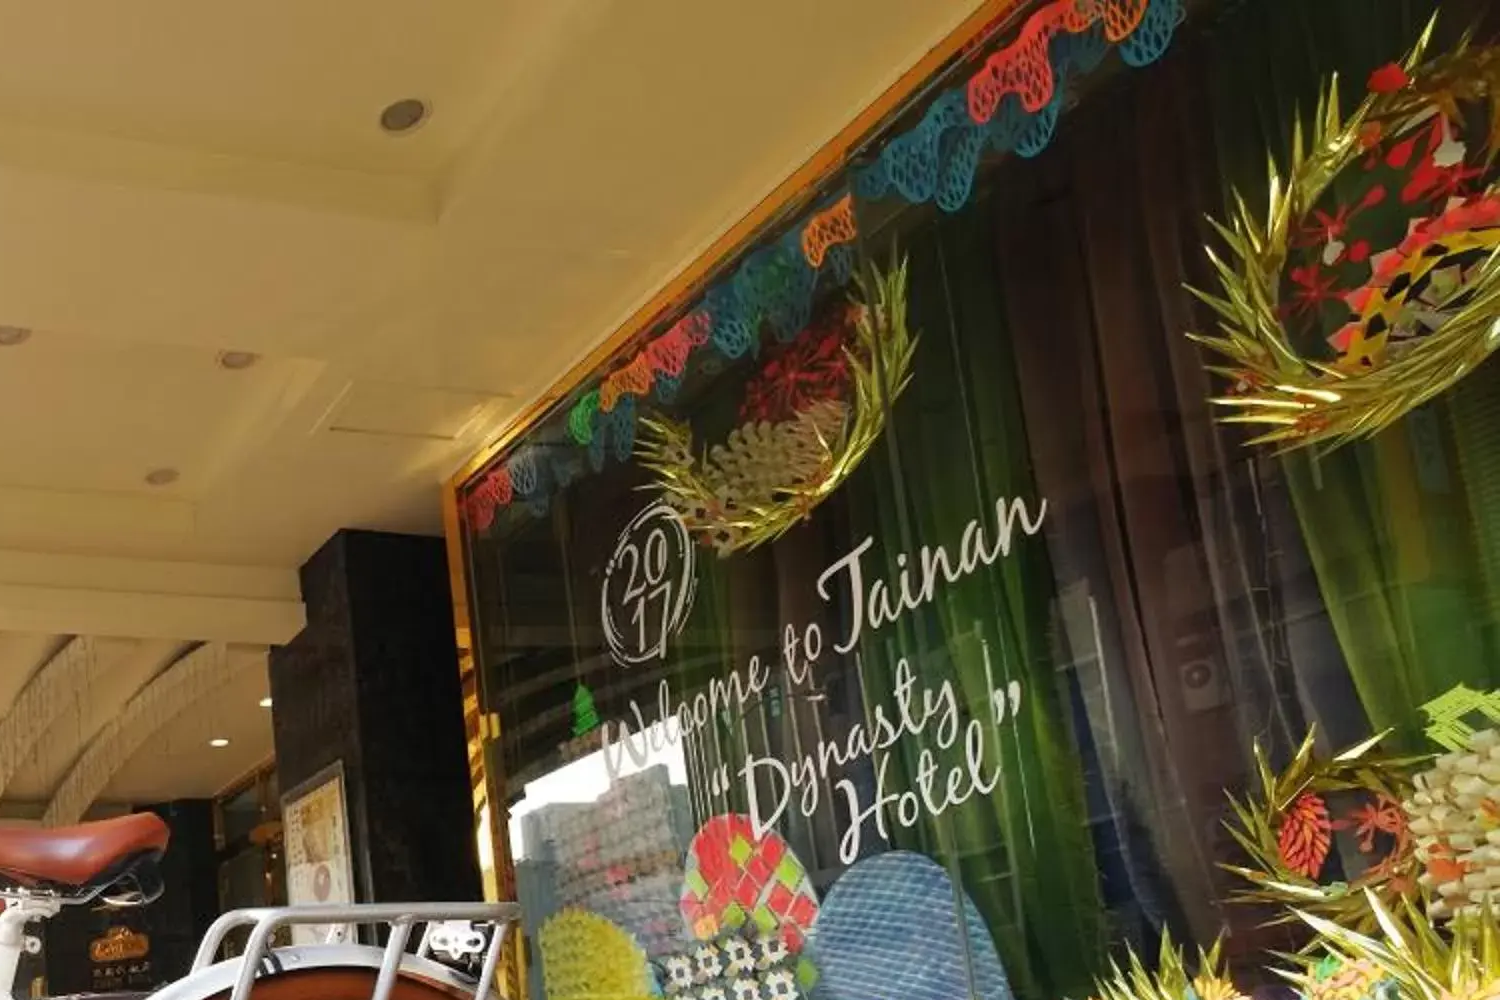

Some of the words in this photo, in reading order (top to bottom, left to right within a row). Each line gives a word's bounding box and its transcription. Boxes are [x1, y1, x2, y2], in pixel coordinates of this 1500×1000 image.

[601, 655, 770, 779] Welcome
[783, 622, 822, 685] to
[817, 496, 1047, 655] Tainan
